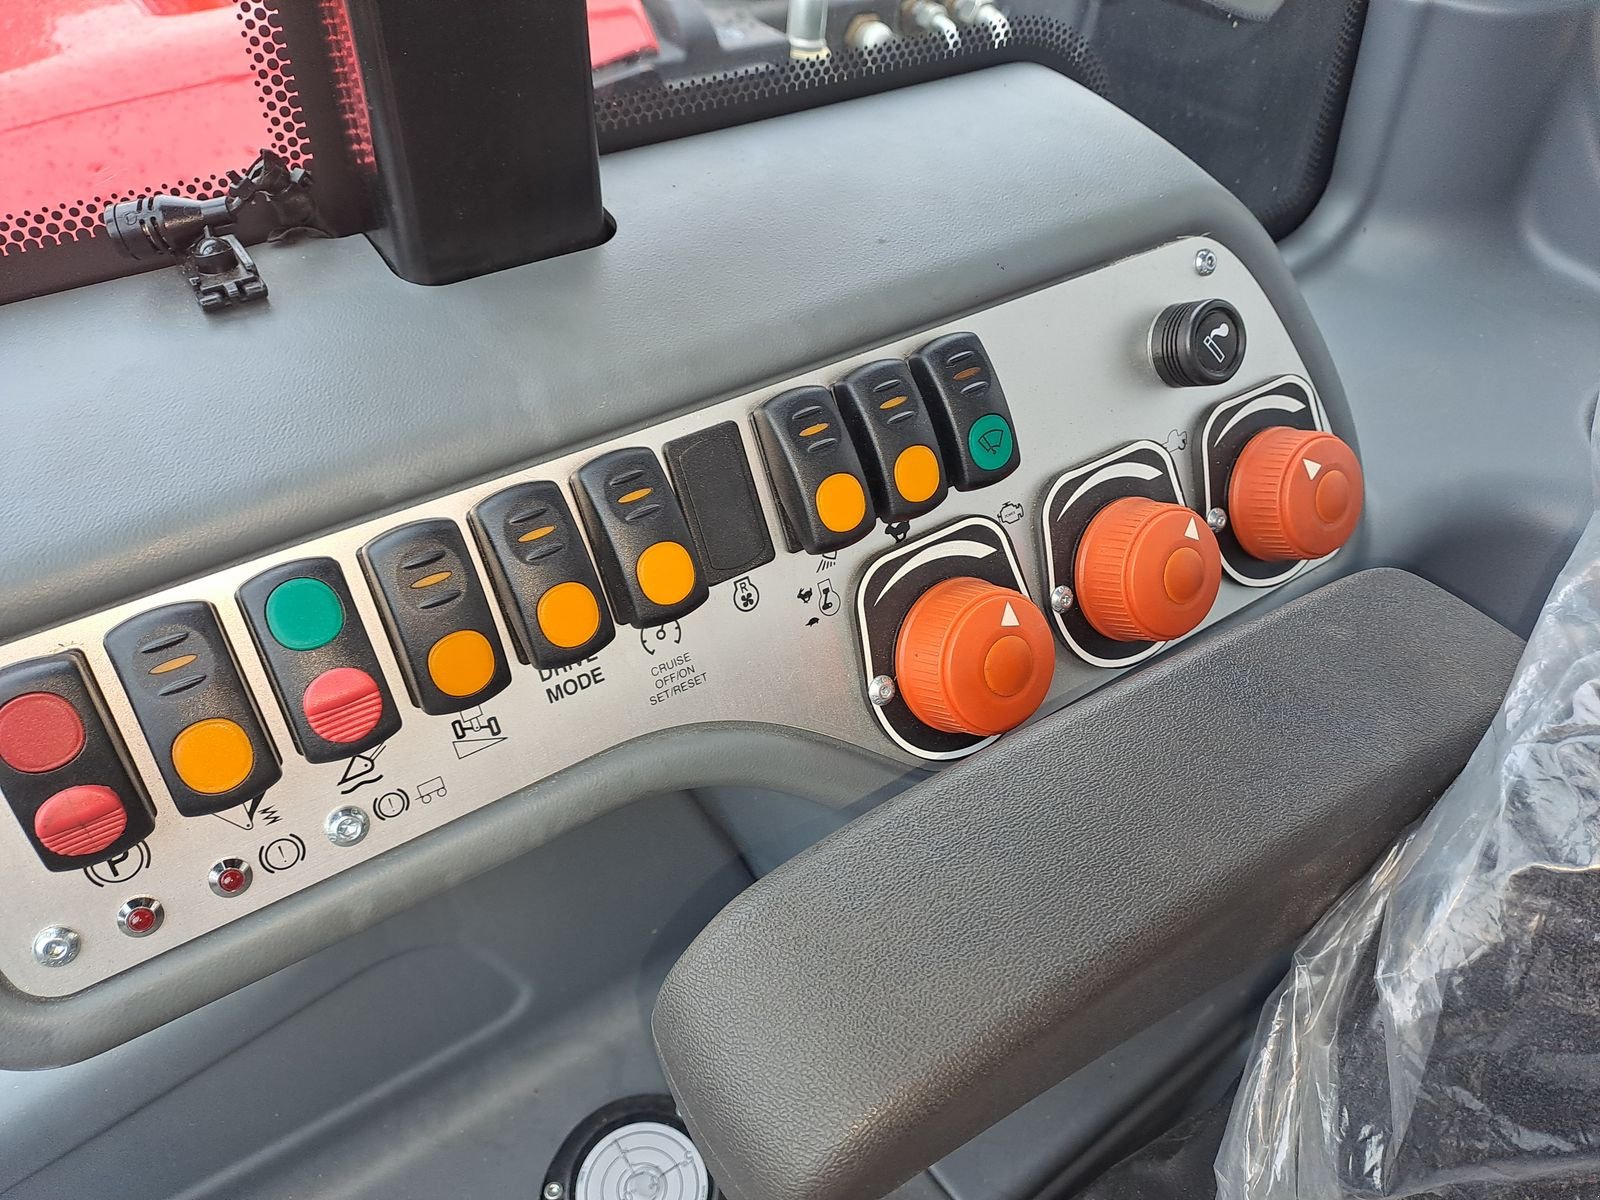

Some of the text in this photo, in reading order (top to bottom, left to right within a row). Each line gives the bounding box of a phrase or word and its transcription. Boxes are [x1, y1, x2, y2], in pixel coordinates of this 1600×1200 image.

[651, 652, 692, 676] CRUISE
[655, 665, 695, 689] OFF/ON
[546, 666, 606, 704] MODE
[649, 672, 707, 706] SET/RESET
